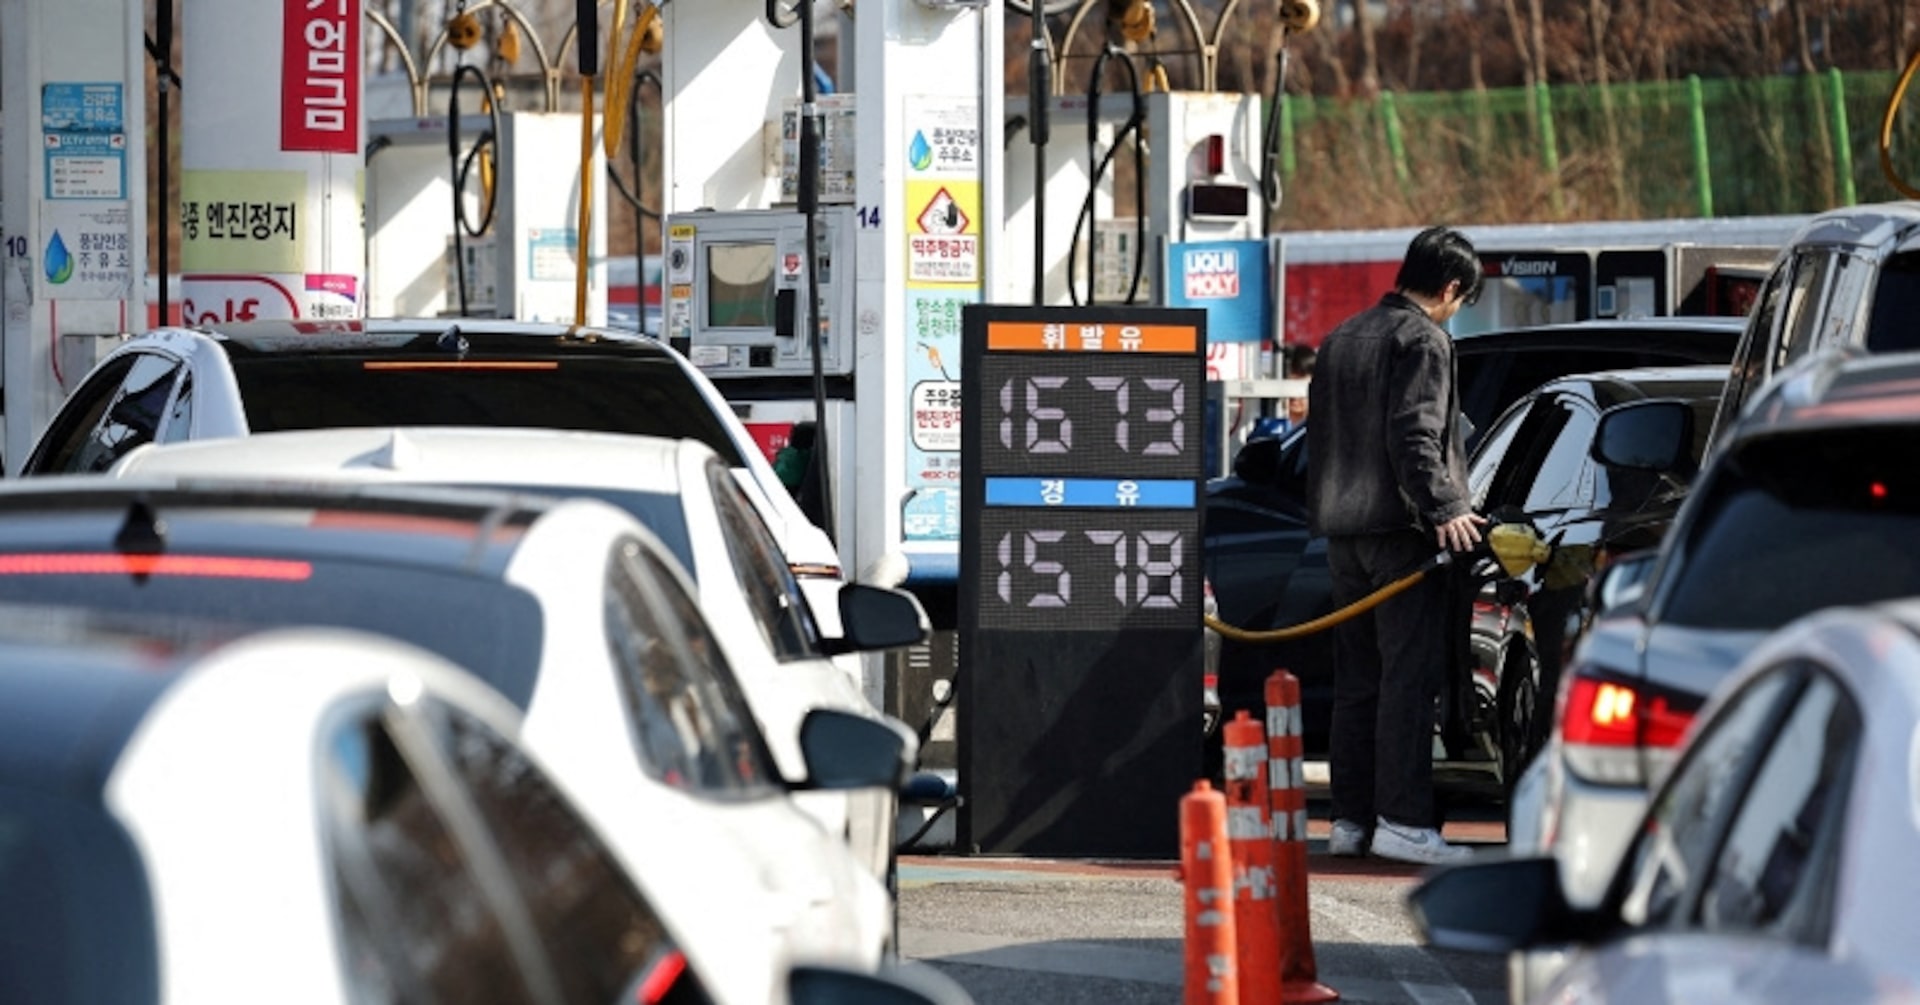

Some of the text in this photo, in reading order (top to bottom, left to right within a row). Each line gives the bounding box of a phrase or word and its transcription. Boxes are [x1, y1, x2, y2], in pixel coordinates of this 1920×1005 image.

[206, 202, 296, 240] 엔진정지
[857, 206, 881, 228] 14
[6, 236, 27, 258] 10
[912, 239, 975, 258] 역주행금지
[1186, 252, 1236, 273] LIQUI
[1186, 273, 1237, 296] MOLY
[999, 376, 1185, 456] 1673
[997, 529, 1183, 608] 1578
